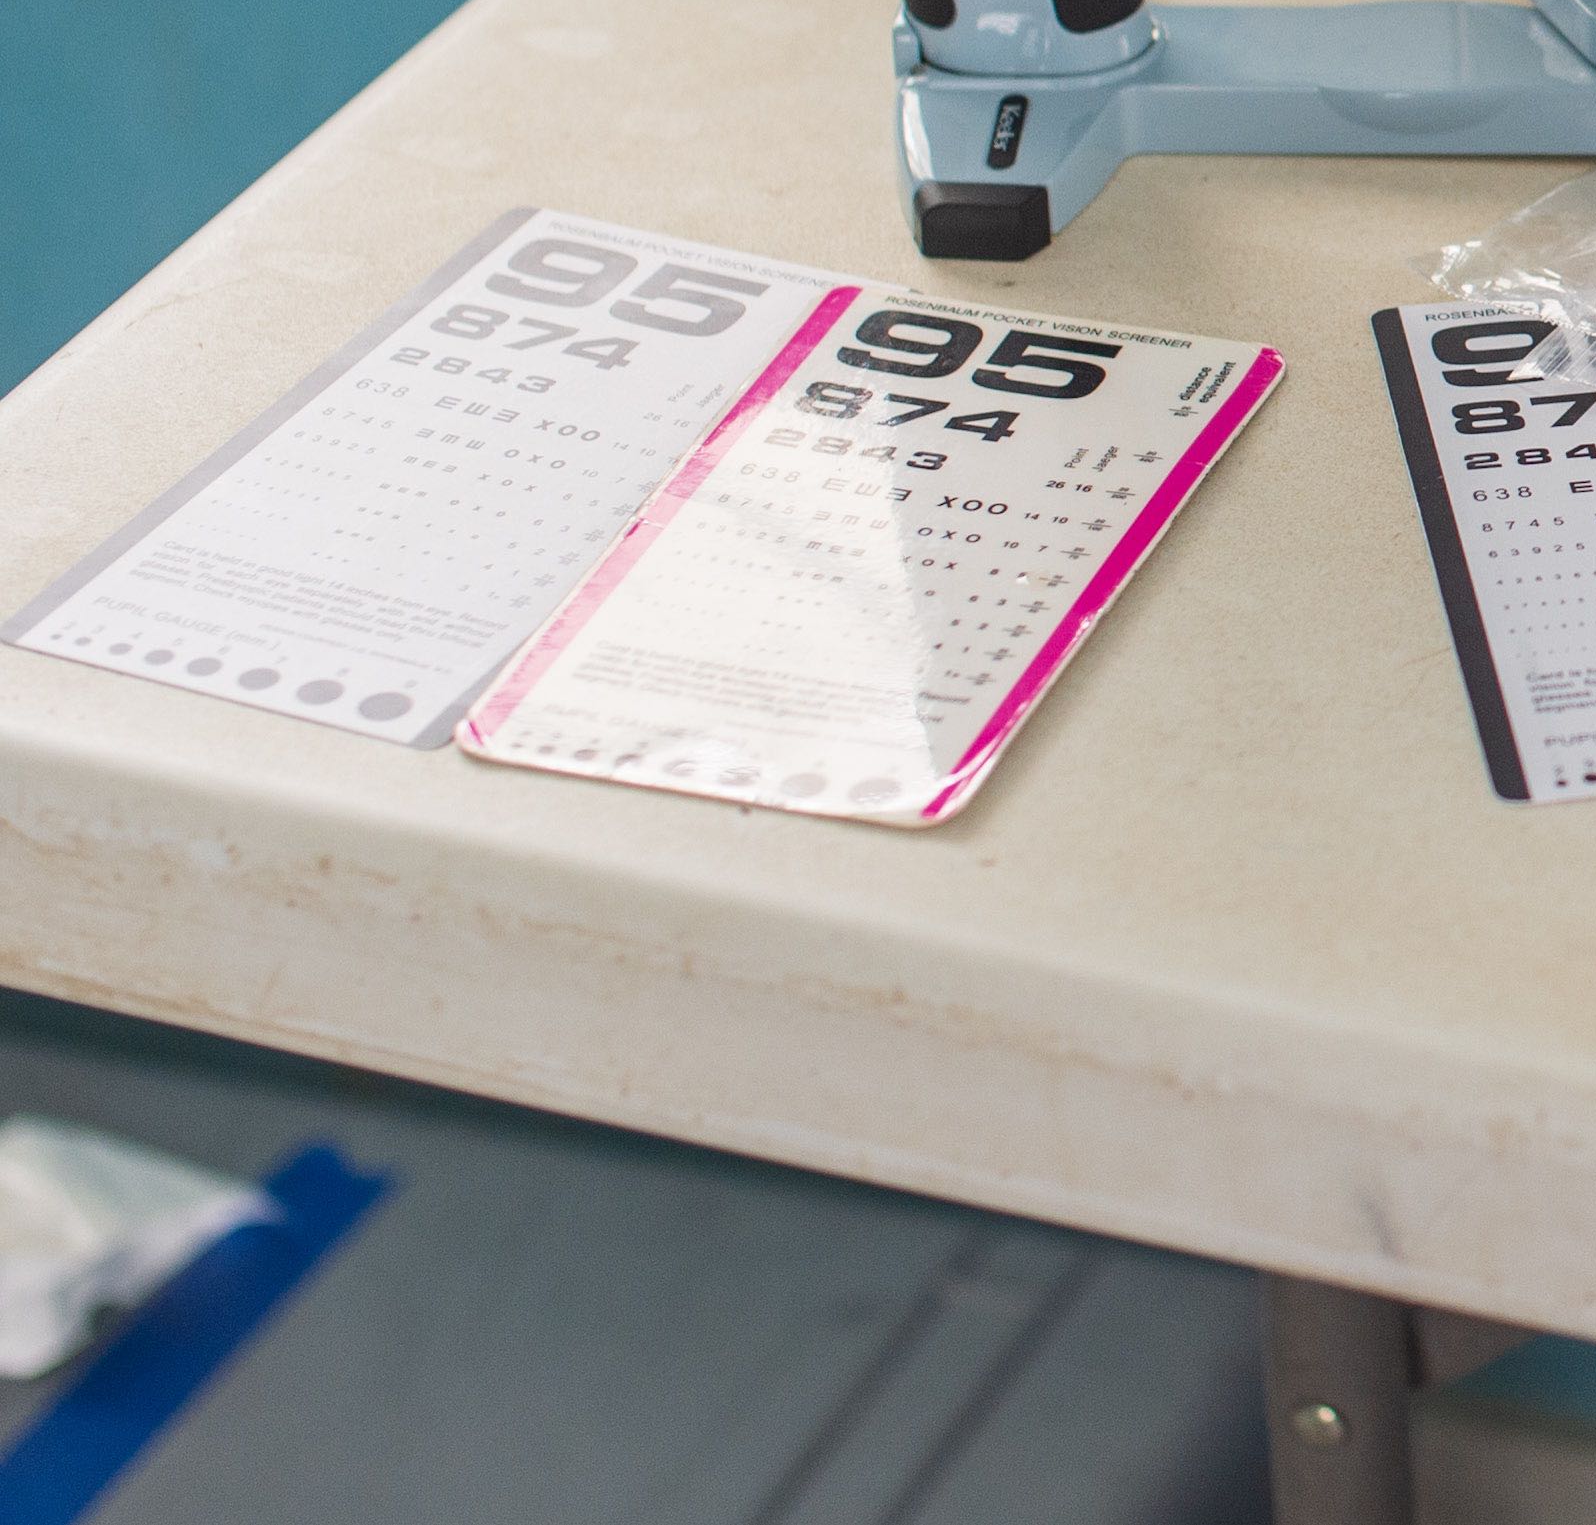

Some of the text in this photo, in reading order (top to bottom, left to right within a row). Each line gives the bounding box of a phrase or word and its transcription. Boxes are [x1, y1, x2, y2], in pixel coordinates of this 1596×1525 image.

[485, 238, 771, 338] 95
[429, 303, 641, 371] 874
[885, 296, 1193, 349] ROSENBAUM POCKET VISION SCREENER
[389, 346, 558, 394] 2843
[837, 310, 1124, 400] 95
[1178, 366, 1213, 401] distance
[1198, 361, 1237, 404] equivalent
[805, 381, 1021, 443] 874
[763, 427, 950, 473] 2843
[1063, 447, 1090, 469] Point
[1092, 445, 1119, 473] Jaeger
[1045, 480, 1093, 493] 26 16
[1472, 485, 1533, 502] 638
[1024, 512, 1040, 521] 14
[1052, 516, 1069, 525] 10
[1003, 540, 1020, 549] 10
